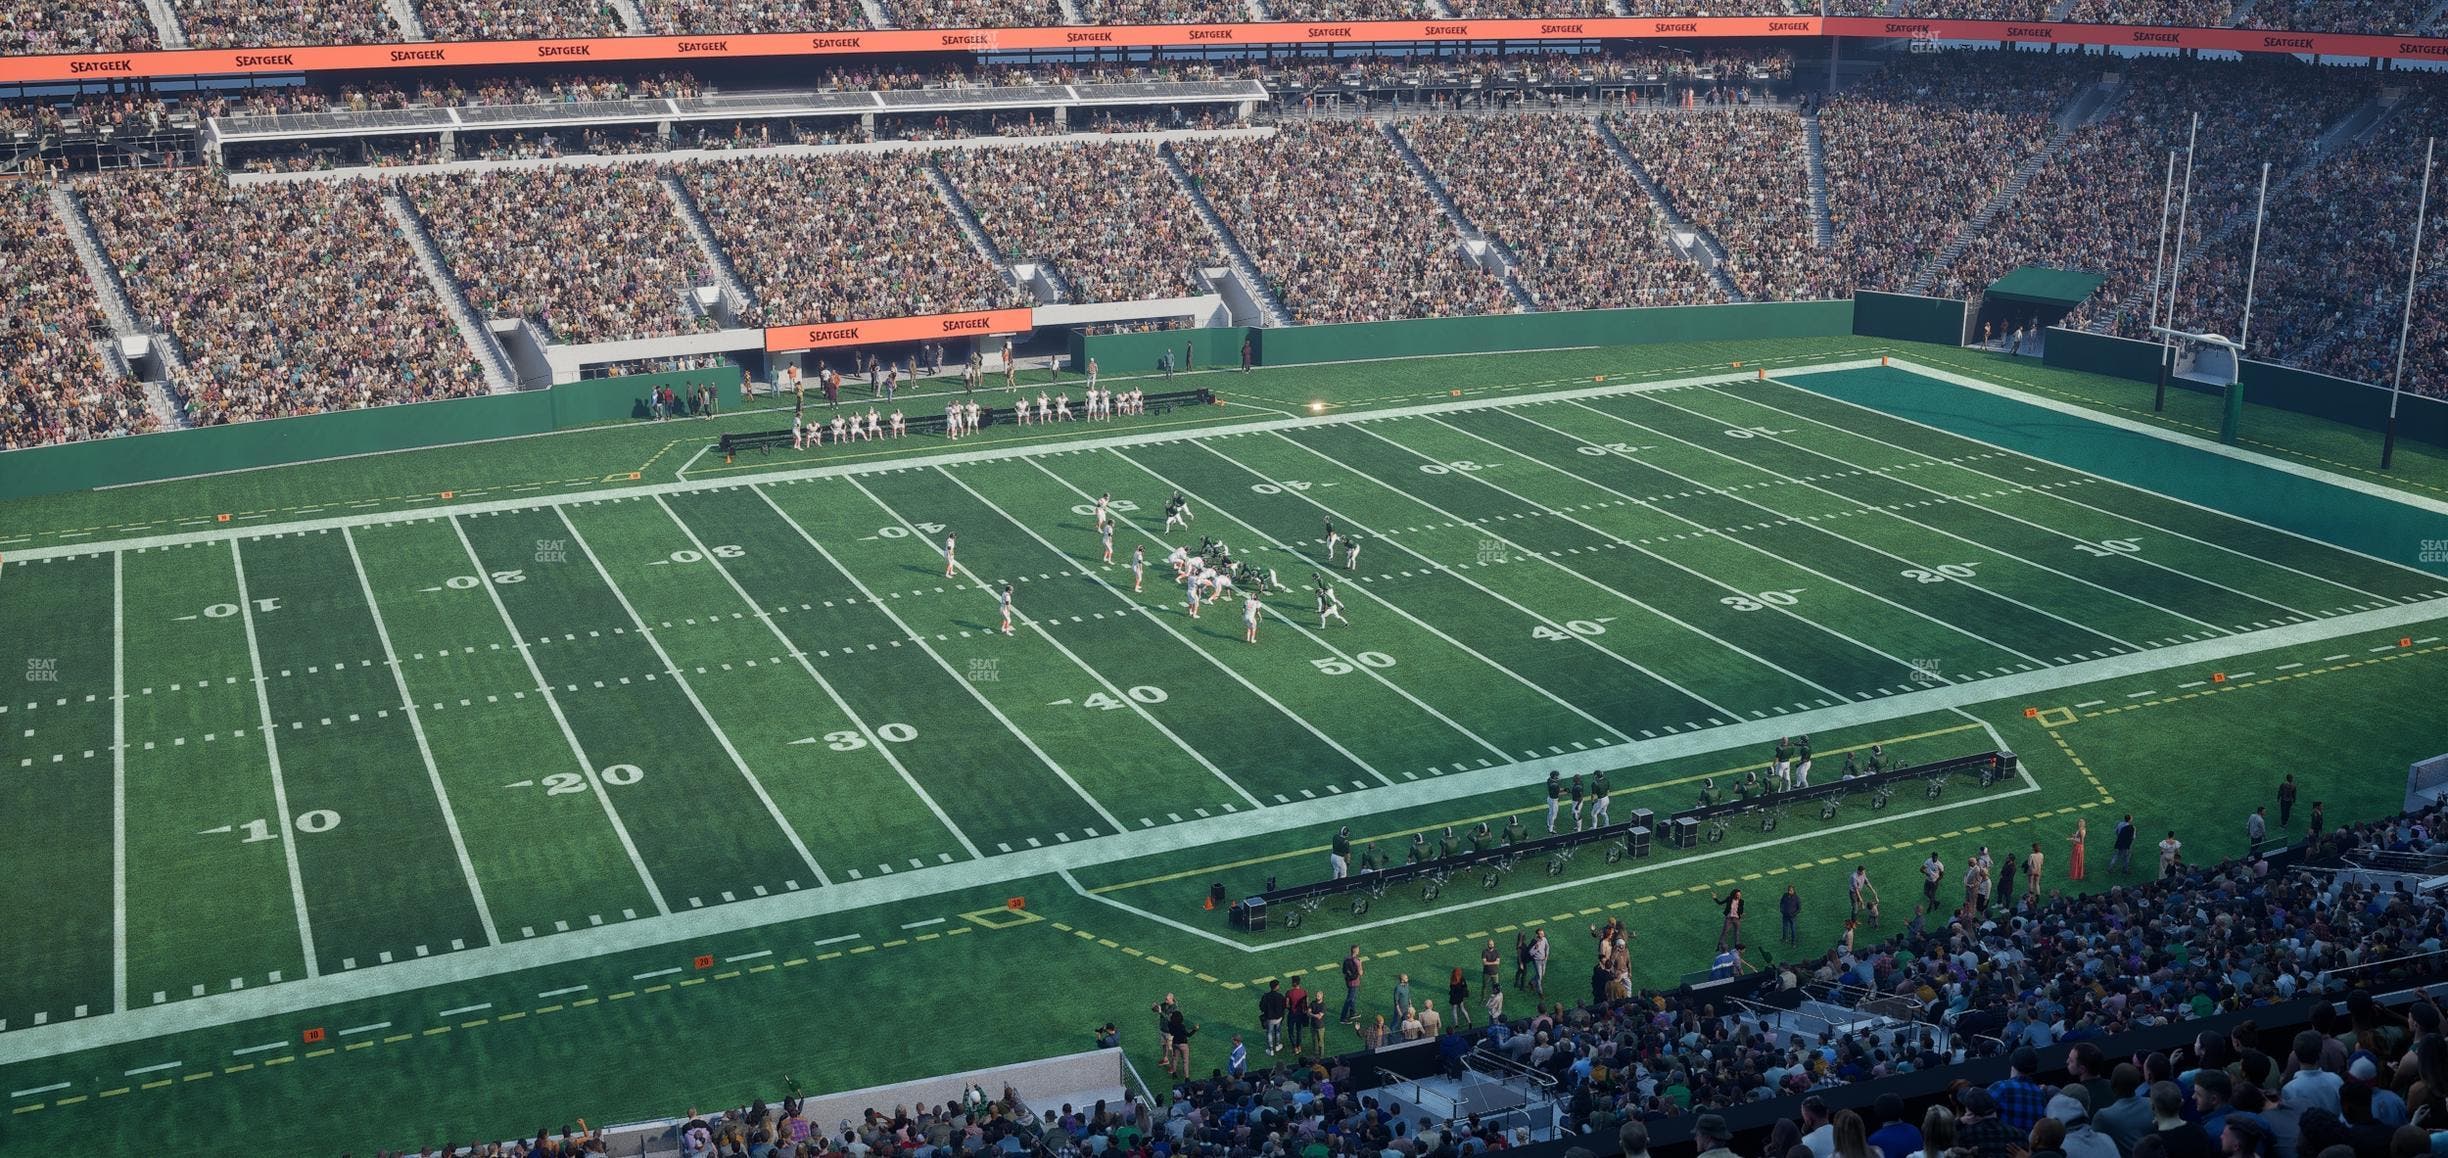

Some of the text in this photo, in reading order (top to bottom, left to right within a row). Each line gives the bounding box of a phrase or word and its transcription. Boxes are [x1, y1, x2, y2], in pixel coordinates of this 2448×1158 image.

[1308, 28, 1351, 38] SEATGEEK
[1425, 26, 1467, 36] SEATGEEK
[1541, 24, 1583, 34] SEATGEEK
[1655, 23, 1697, 33] SEATGEEK
[1768, 22, 1809, 32] SEATGEEK
[1885, 23, 1930, 33] SEATGEEK
[2007, 27, 2053, 38] SEATGEEK
[942, 35, 988, 45] SEATGEEK
[1066, 32, 1112, 43] SEATGEEK
[1188, 29, 1233, 40] SEATGEEK
[2133, 31, 2180, 43] SEATGEEK
[677, 41, 728, 53] SEATGEEK
[812, 37, 861, 48] SEATGEEK
[2263, 37, 2314, 49] SEATGEEK
[390, 49, 445, 62] SEATGEEK
[538, 45, 590, 57] SEATGEEK
[70, 60, 132, 74] SEATGEEK
[236, 54, 294, 67] SEATGEEK
[942, 317, 990, 332] SEATGEEK
[809, 327, 859, 342] SEATGEEK
[1724, 426, 1779, 440] 10
[1576, 442, 1639, 456] 20
[1419, 460, 1483, 475] 30
[1250, 480, 1312, 494] 40
[1071, 499, 1140, 516] 50
[877, 522, 946, 538] 40
[670, 544, 746, 563] 30
[2072, 539, 2141, 557] 10
[446, 569, 526, 590] 20
[1900, 564, 1976, 584] 20
[203, 597, 281, 618] 10
[1720, 591, 1799, 611] 30
[1531, 620, 1606, 641] 40
[1310, 651, 1397, 676] 50
[1083, 685, 1168, 711] 40
[823, 722, 918, 751] 30
[541, 763, 644, 796] 20
[240, 809, 341, 843] 10
[699, 957, 709, 967] 20
[309, 1030, 319, 1040] 10
